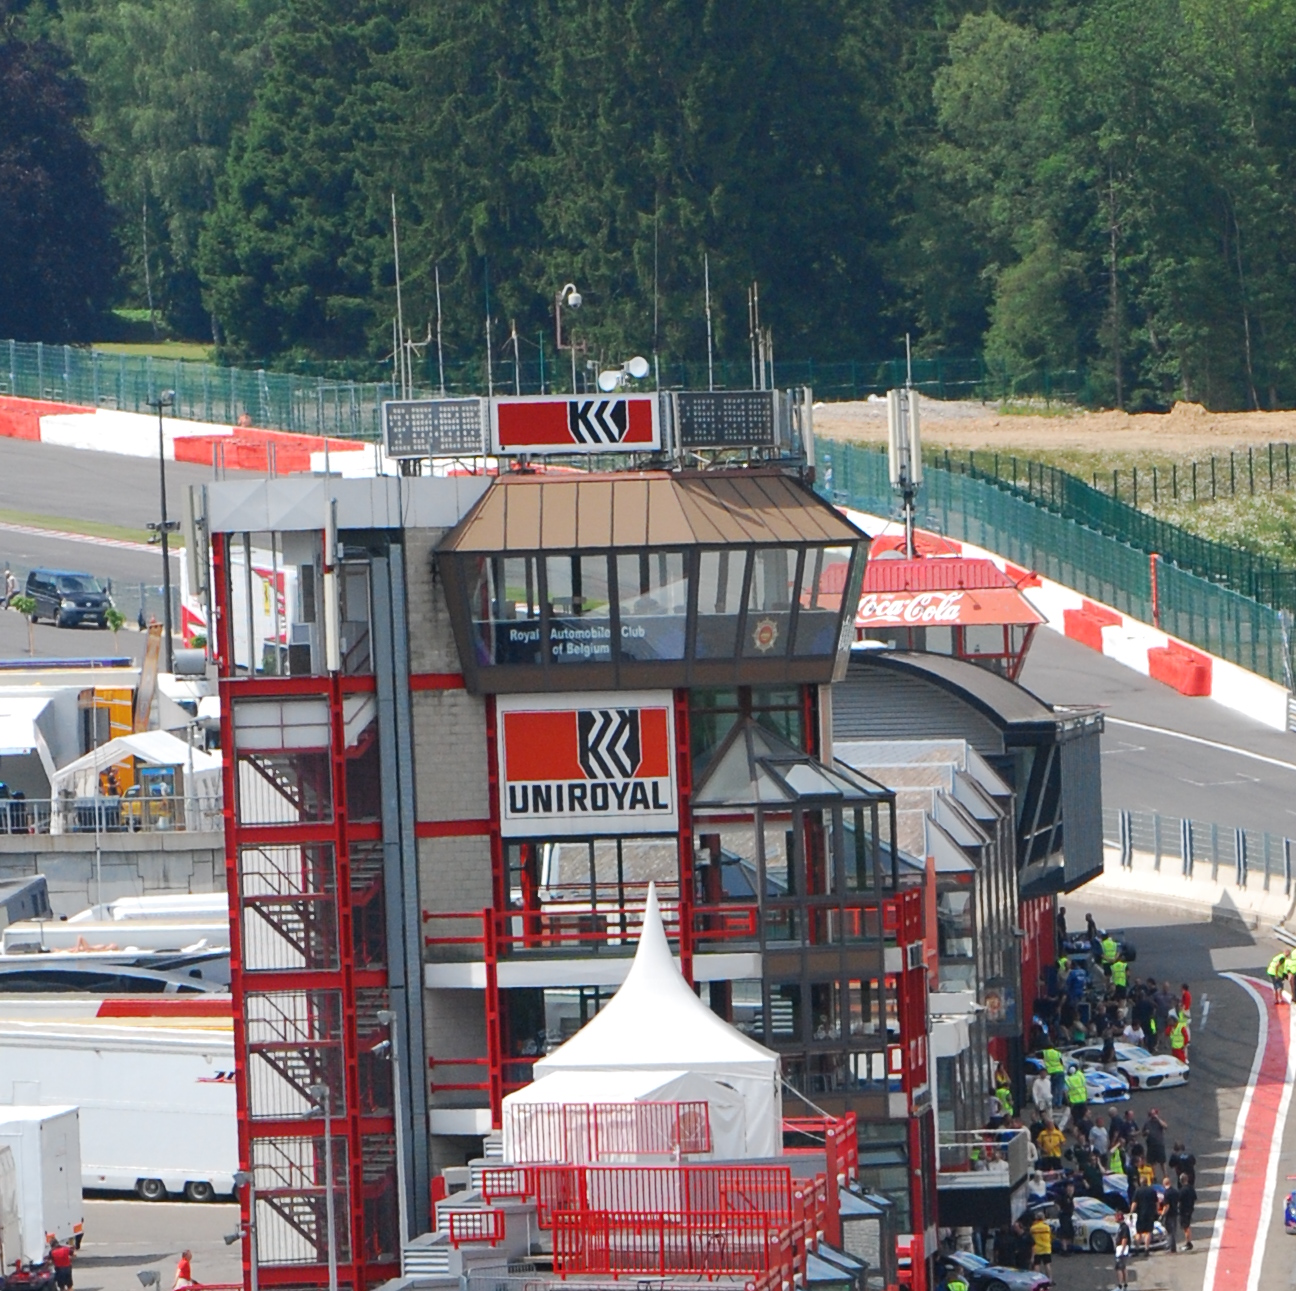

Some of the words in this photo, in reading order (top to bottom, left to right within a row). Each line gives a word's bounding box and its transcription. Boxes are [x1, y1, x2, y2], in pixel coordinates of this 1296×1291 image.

[510, 629, 540, 643] Royal
[550, 627, 611, 639] Automobile
[621, 625, 646, 638] Club
[552, 643, 563, 654] of
[566, 643, 610, 657] Belgium
[509, 781, 669, 813] UNIROYAL
